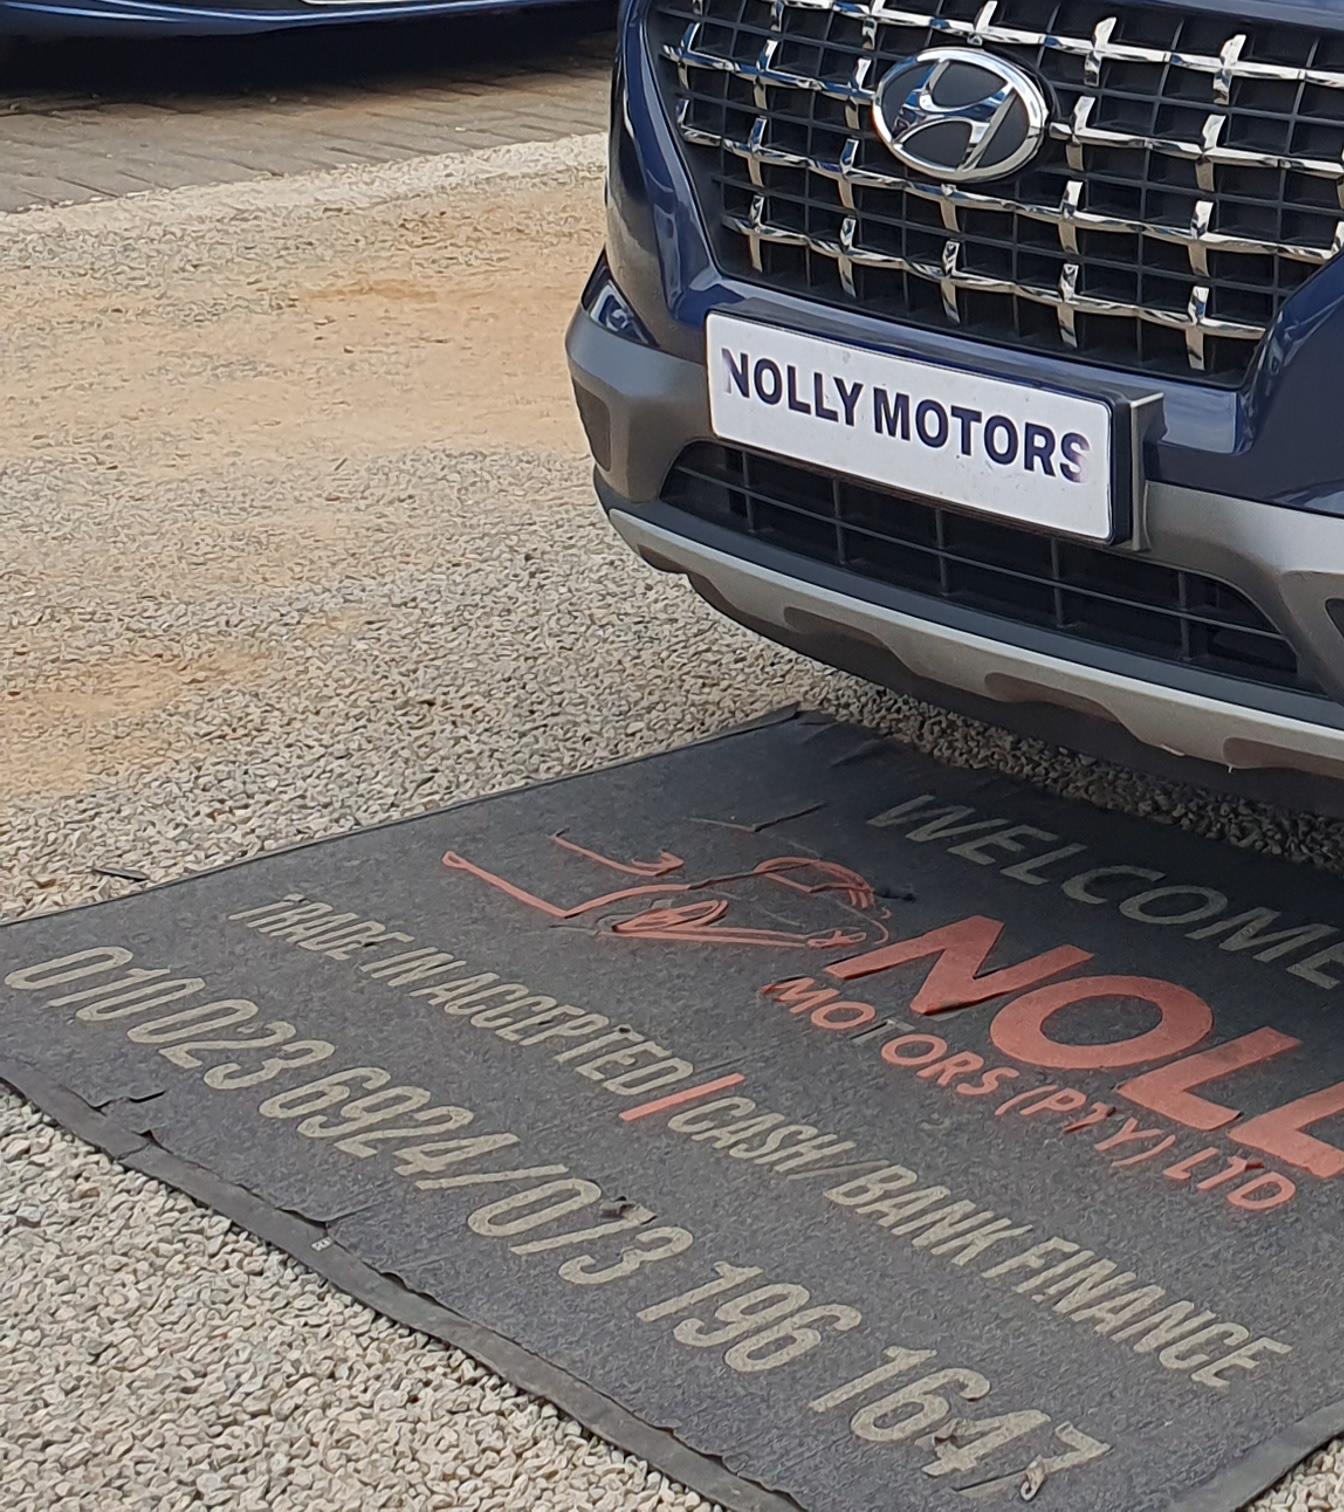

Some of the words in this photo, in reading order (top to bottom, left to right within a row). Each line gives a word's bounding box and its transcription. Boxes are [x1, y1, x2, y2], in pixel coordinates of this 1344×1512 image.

[720, 347, 864, 427] NOLLY
[873, 386, 1092, 485] MOTORS
[227, 893, 415, 961] TRADE
[359, 946, 467, 987] IN
[408, 972, 694, 1096] ACCEPTED
[761, 976, 1019, 1096] MOTORS
[995, 1086, 1177, 1169] (PTY)
[1163, 1146, 1296, 1211] LTD
[636, 1260, 864, 1373] 196
[809, 1345, 1114, 1501] 1647
[981, 1235, 1293, 1388] FINANCE
